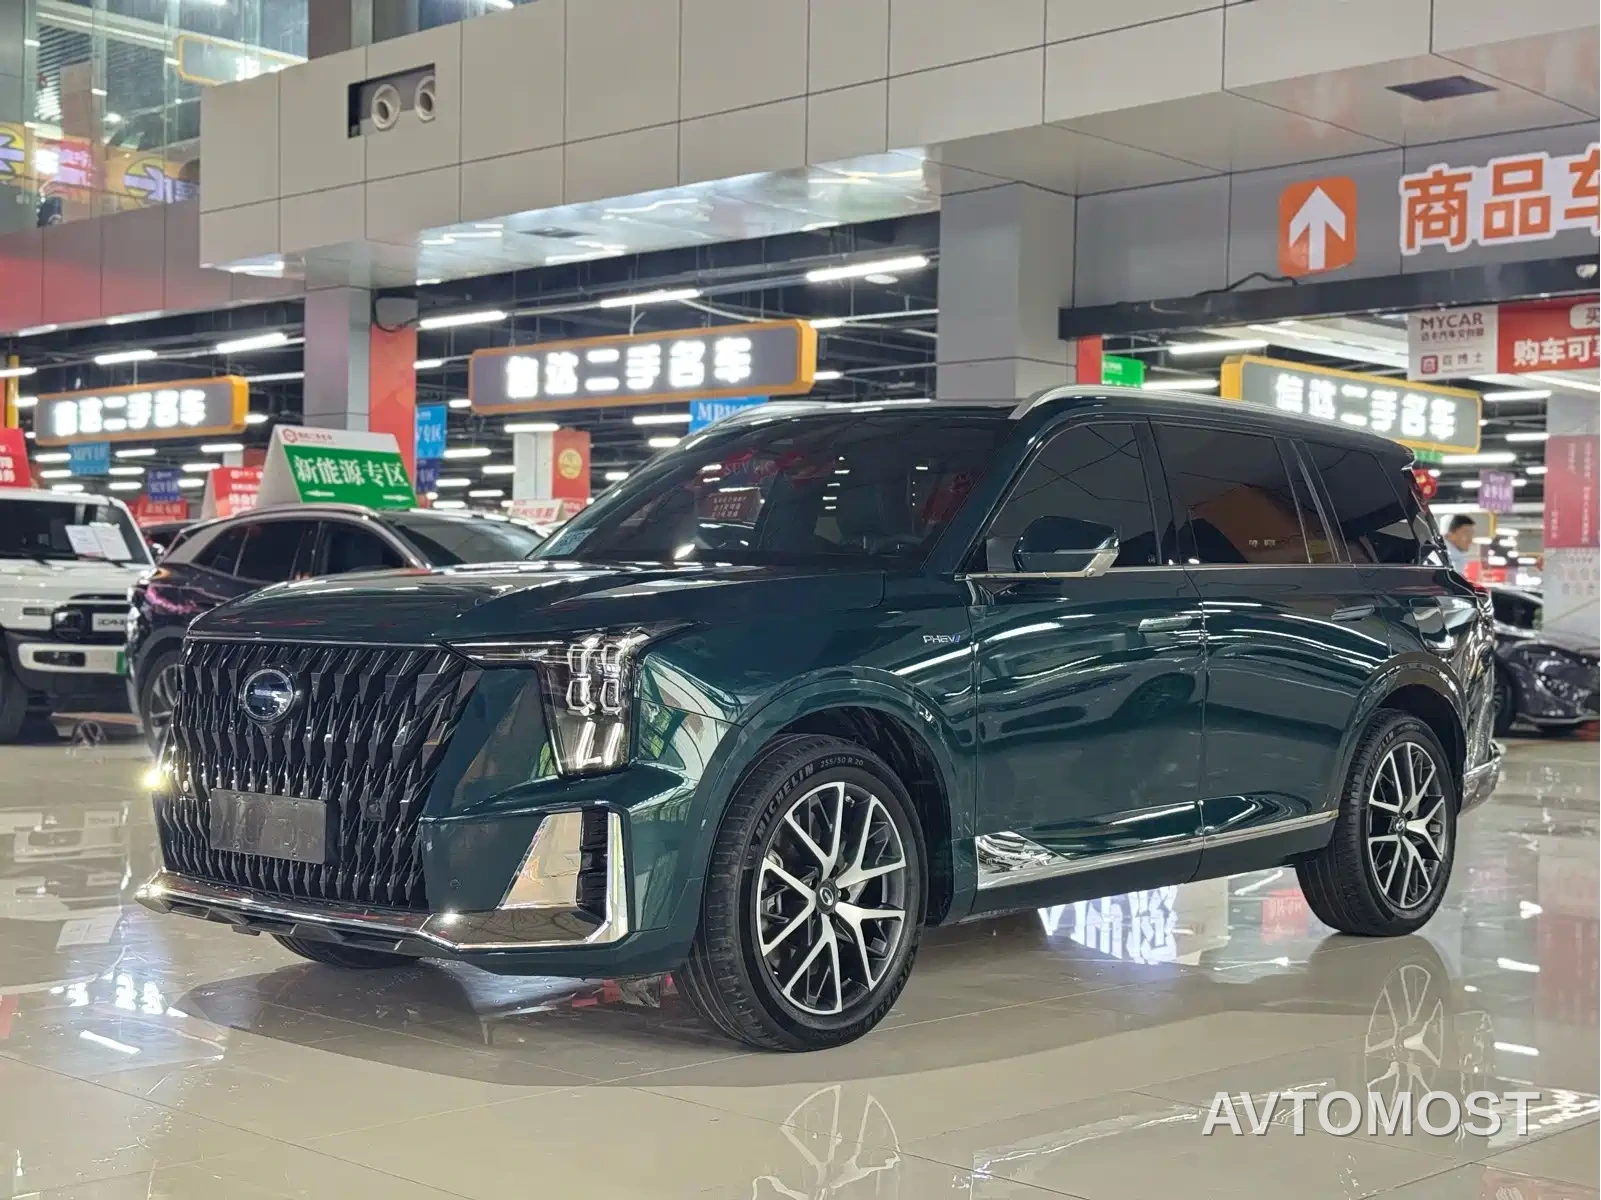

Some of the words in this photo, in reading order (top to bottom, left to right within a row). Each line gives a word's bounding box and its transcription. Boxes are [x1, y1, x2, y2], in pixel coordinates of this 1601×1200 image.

[1420, 312, 1484, 331] MYCAR
[292, 455, 410, 489] 新能源专区
[756, 763, 814, 840] MICHELIN
